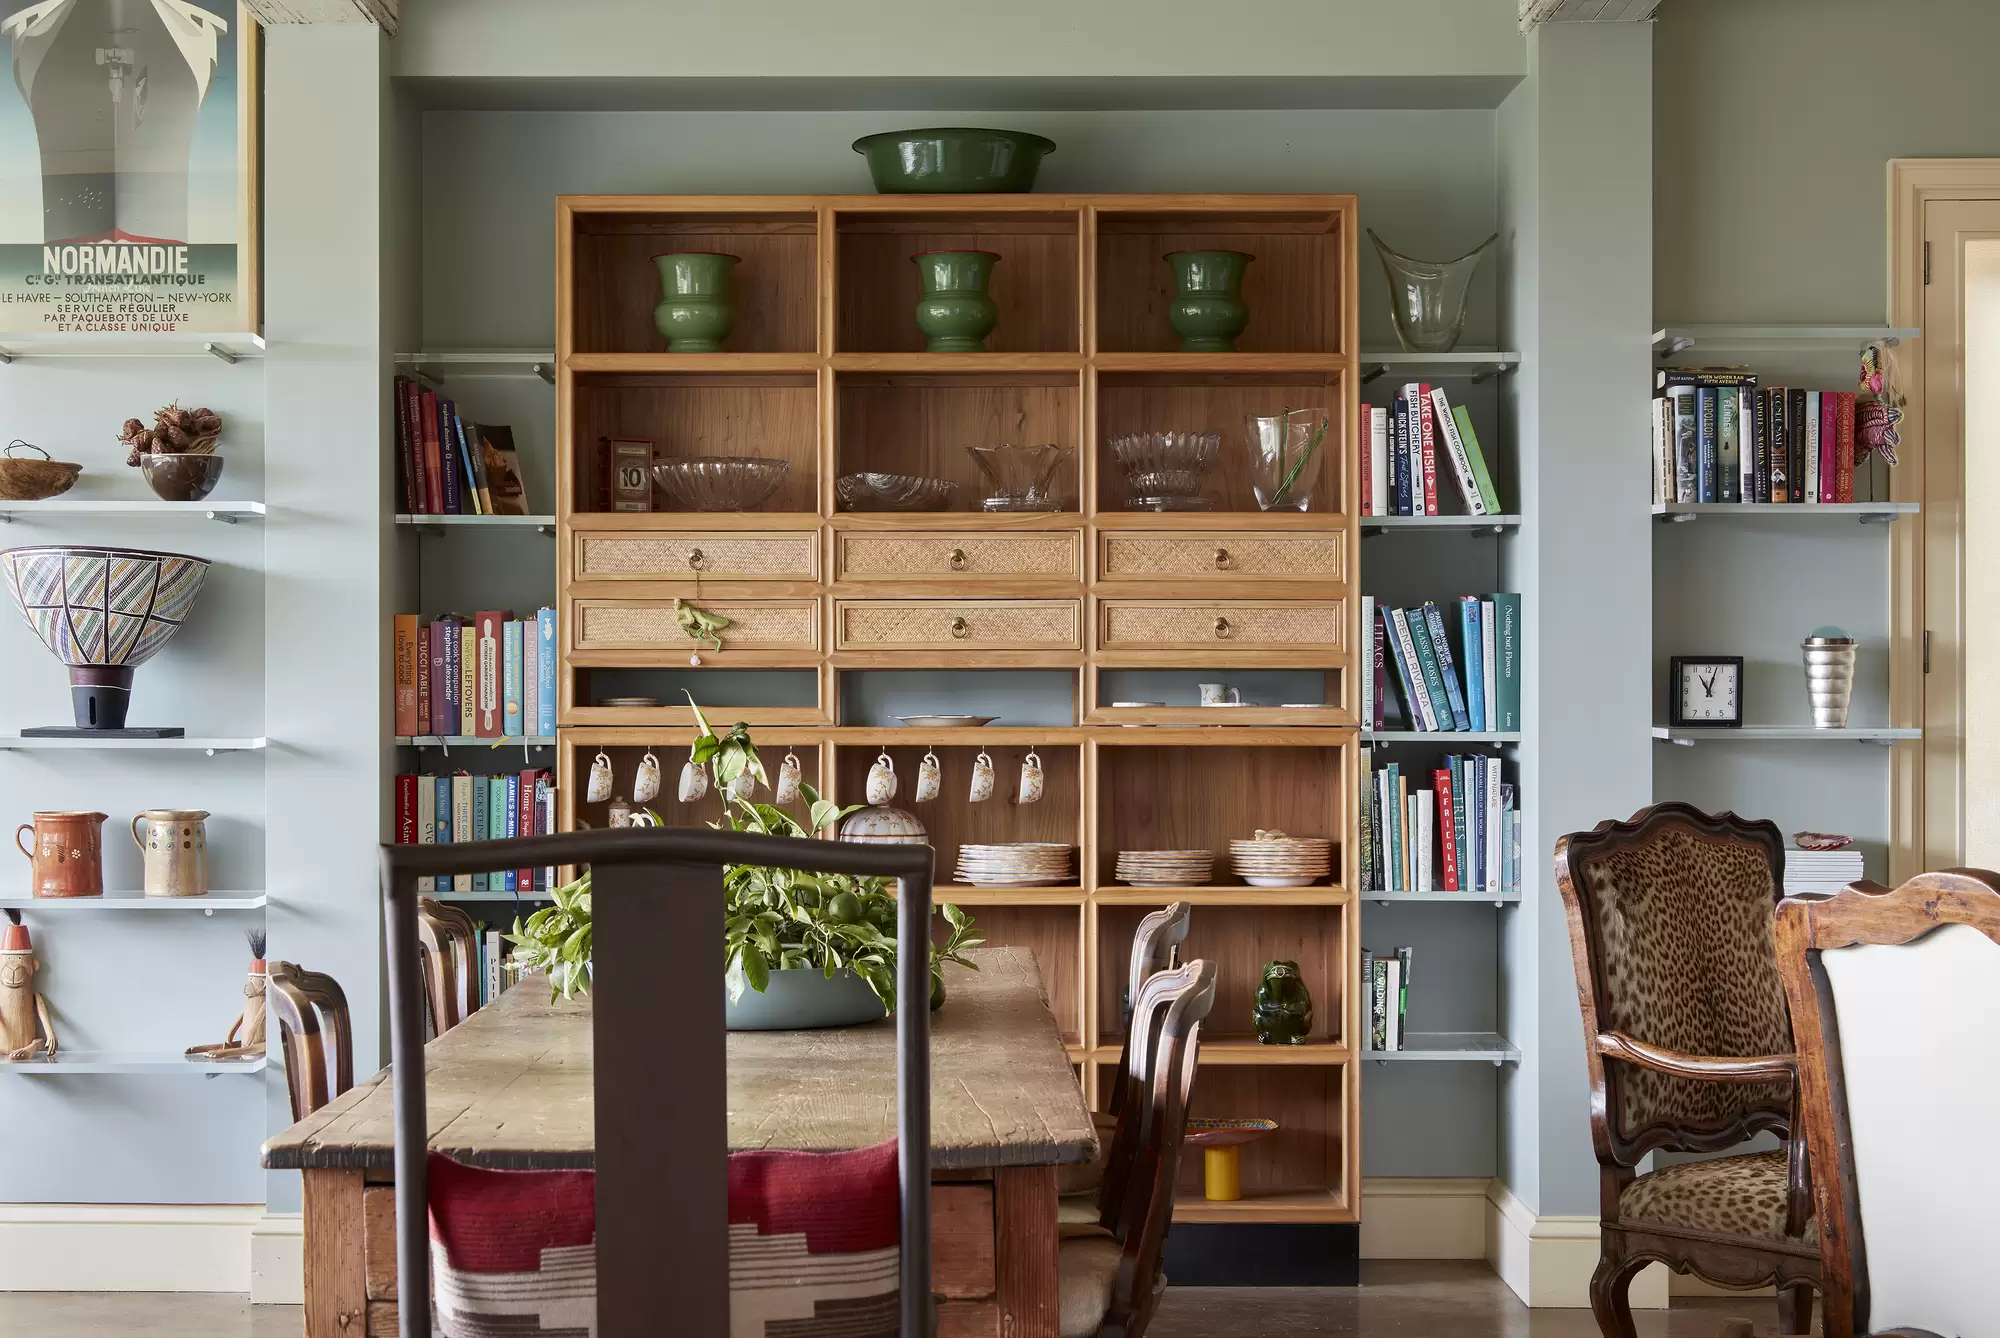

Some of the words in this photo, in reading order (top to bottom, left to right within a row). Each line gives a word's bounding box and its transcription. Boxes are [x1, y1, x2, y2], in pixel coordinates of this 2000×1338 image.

[43, 246, 188, 274] NORMANDIE
[65, 274, 205, 286] TRANSATLANTIQUE
[2, 293, 13, 303] LE
[16, 293, 51, 303] HAVRE
[65, 293, 153, 303] SOUTHAMPTON
[168, 293, 232, 303] NEW-YORK
[57, 304, 113, 312] SERVICE
[120, 302, 175, 312] RÉGULIER
[44, 314, 68, 322] PAR
[72, 314, 137, 323] PAQUEBOTS
[143, 314, 155, 322] DE
[161, 314, 188, 322] LUXE
[58, 323, 71, 331] ET
[75, 323, 82, 331] A
[87, 323, 126, 332] CLASSE
[132, 323, 175, 332] UNIQUE
[1410, 391, 1418, 408] FISH
[1420, 392, 1431, 419] TAKE
[1438, 397, 1446, 407] THE
[1398, 413, 1406, 429] RICK
[1441, 408, 1453, 427] WHOLE
[1704, 397, 1713, 438] NAPOLEON
[1723, 400, 1731, 437] FLINDERS
[1399, 429, 1407, 454] STEIN'S
[1411, 411, 1420, 455] BUTCHERY
[1422, 422, 1433, 446] ONE
[1447, 428, 1458, 441] FISH
[1424, 450, 1434, 473] FISH
[1452, 441, 1468, 474] COOKBOOK
[622, 468, 641, 487] 10
[1428, 613, 1437, 634] GUIDE
[1434, 611, 1442, 629] PAUL
[1504, 605, 1512, 635] (Nothing
[1374, 624, 1383, 668] LILACS
[1433, 634, 1440, 644] TO
[404, 642, 413, 685] Everything
[1394, 612, 1414, 659] FRENCH
[1410, 662, 1428, 708] RIVIERA
[1415, 625, 1430, 658] CLASSIC
[1425, 660, 1439, 686] ROSES
[1436, 645, 1448, 671] PLANTS
[398, 690, 406, 712] Perry
[1364, 686, 1371, 697] my
[523, 784, 532, 811] Home
[1453, 794, 1465, 840] TREES
[403, 816, 412, 844] Asian
[425, 823, 433, 843] eve
[1442, 786, 1454, 873] AFRICOLA
